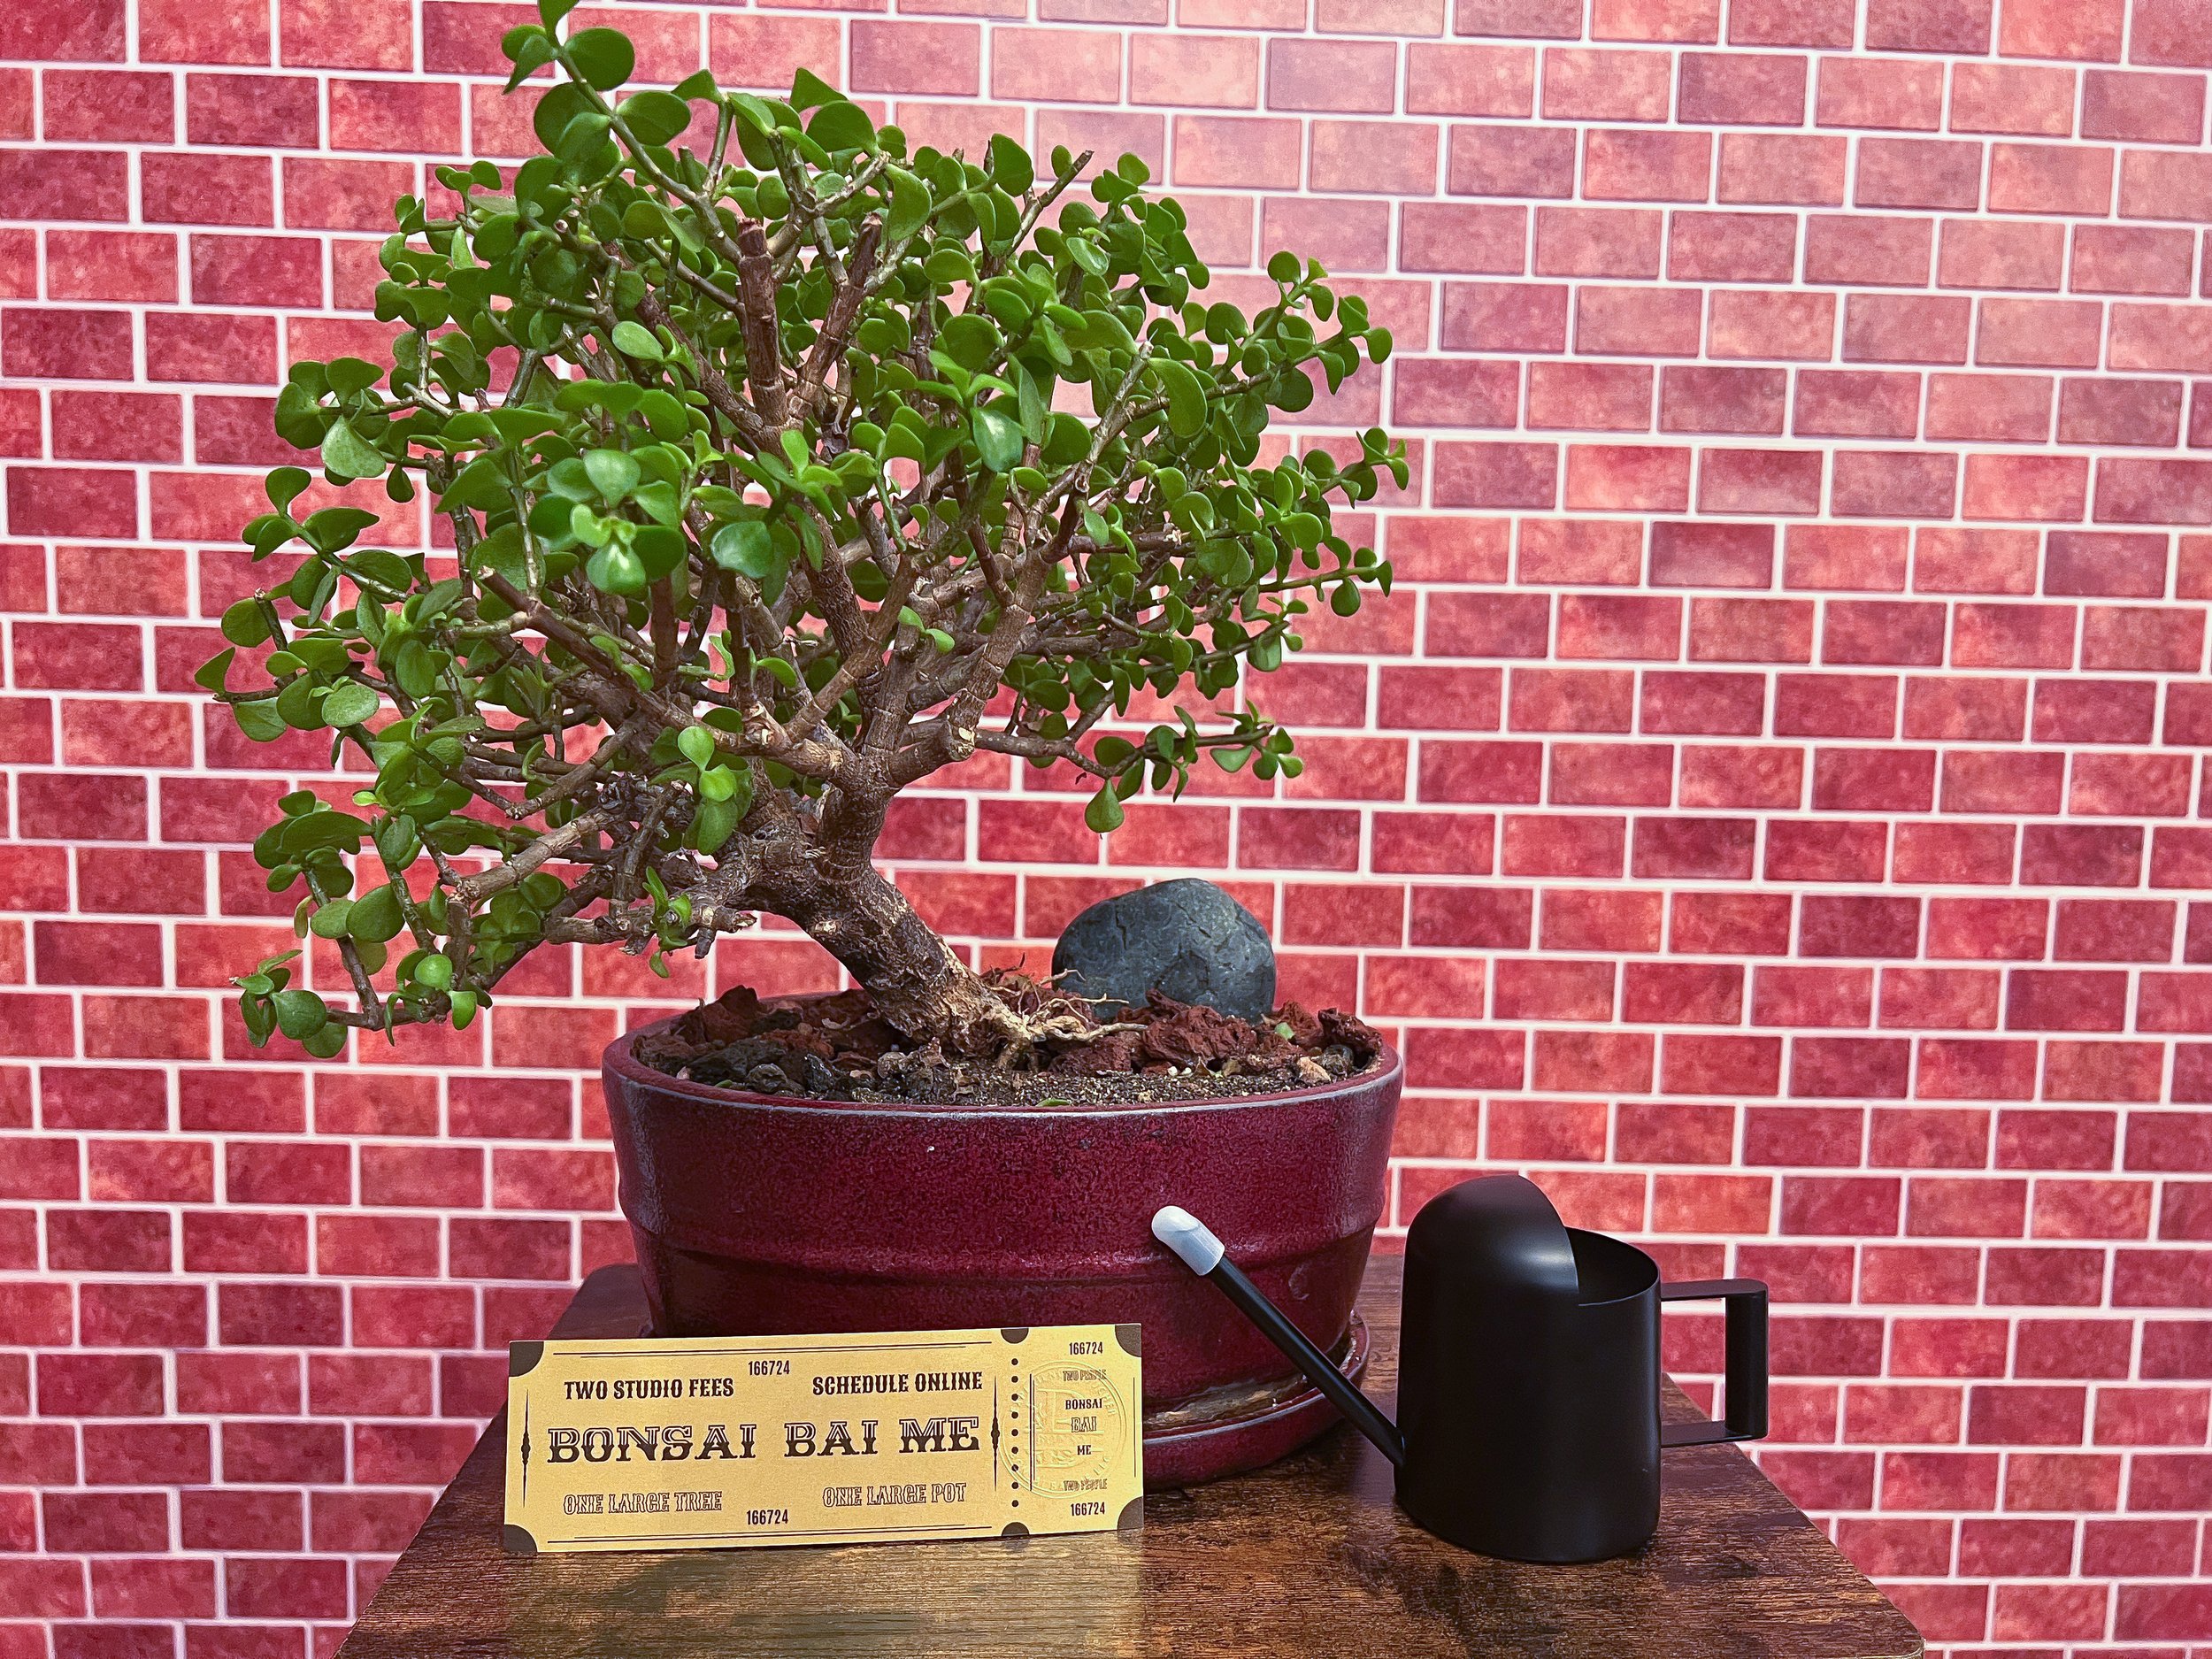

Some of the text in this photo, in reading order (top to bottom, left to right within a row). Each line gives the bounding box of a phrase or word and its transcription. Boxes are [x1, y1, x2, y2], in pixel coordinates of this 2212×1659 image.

[1069, 1341, 1103, 1356] 166724
[748, 1360, 790, 1376] 166724
[564, 1378, 734, 1401] TWO STUDIO FEES
[812, 1373, 910, 1396] SCHEDULE
[914, 1371, 983, 1393] ONLINE
[1065, 1398, 1102, 1410] BONSAI
[1071, 1416, 1097, 1433] BAI
[547, 1424, 757, 1463] BONSAI
[783, 1419, 879, 1457] BAI
[898, 1416, 980, 1454] ME
[1077, 1444, 1092, 1455] ME
[563, 1490, 723, 1516] ONE LARGE TREE
[822, 1482, 967, 1508] ONE LARGE POT
[746, 1509, 789, 1525] 166724
[1070, 1502, 1105, 1517] 166724
